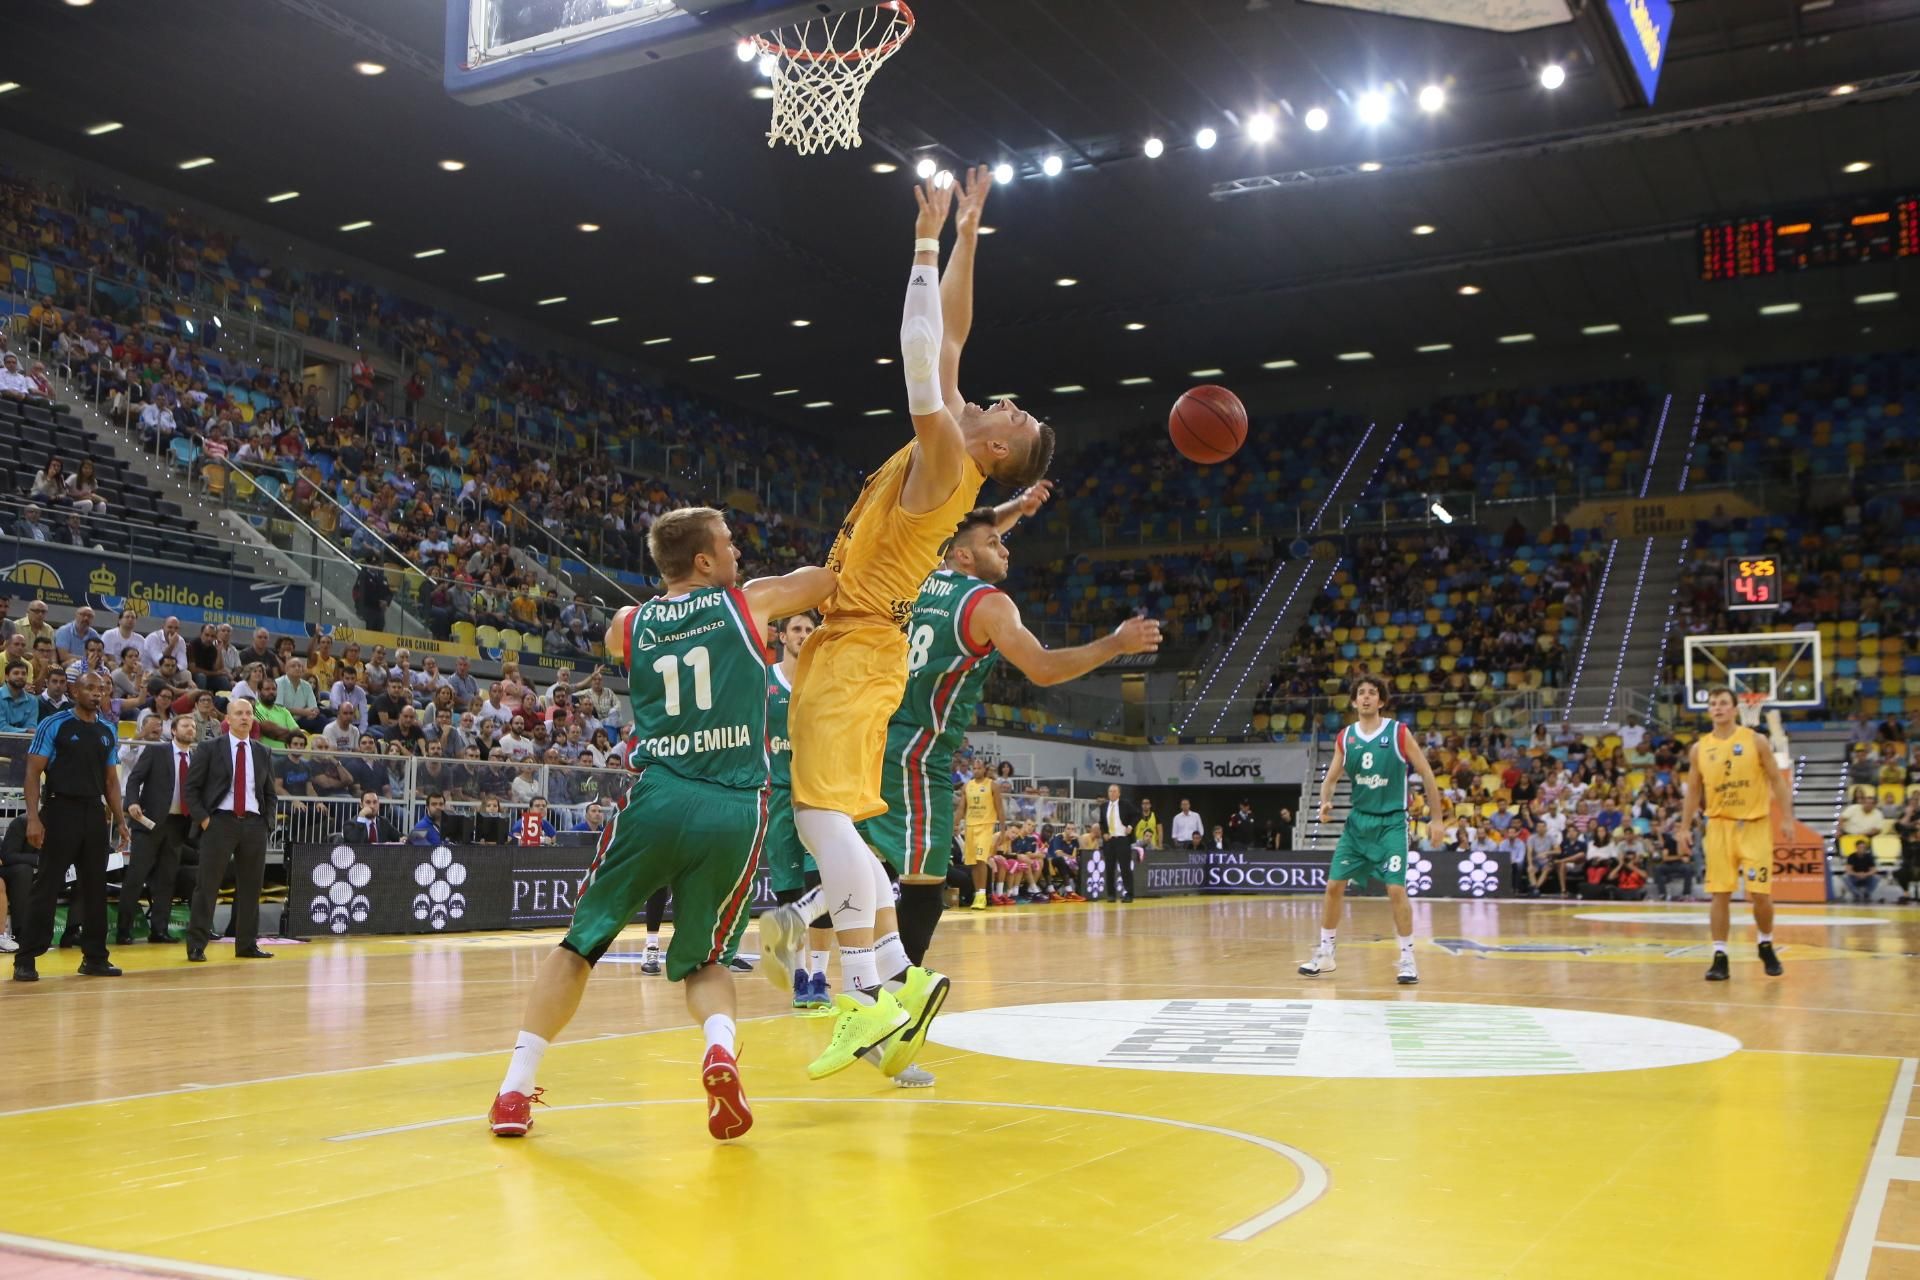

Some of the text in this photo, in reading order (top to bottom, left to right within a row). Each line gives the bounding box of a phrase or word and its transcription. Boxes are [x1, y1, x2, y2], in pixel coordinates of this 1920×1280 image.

[1739, 560, 1775, 577] 5:25
[130, 581, 224, 610] Cabildo de
[642, 592, 722, 623] SRAUTINS
[203, 609, 258, 628] GRAN CANARIA
[657, 620, 726, 643] LANDIRENZO
[396, 637, 440, 653] GRAN CANARIA
[538, 656, 553, 668] GRAN
[652, 646, 712, 716] 11
[693, 724, 751, 753] EMILIA
[1203, 761, 1261, 778] Ralons
[1362, 752, 1374, 769] 8
[528, 816, 539, 837] 5
[1389, 855, 1401, 872] 8
[1147, 867, 1204, 887] PERPETUO
[1758, 867, 1768, 883] 3
[512, 878, 582, 911] PER
